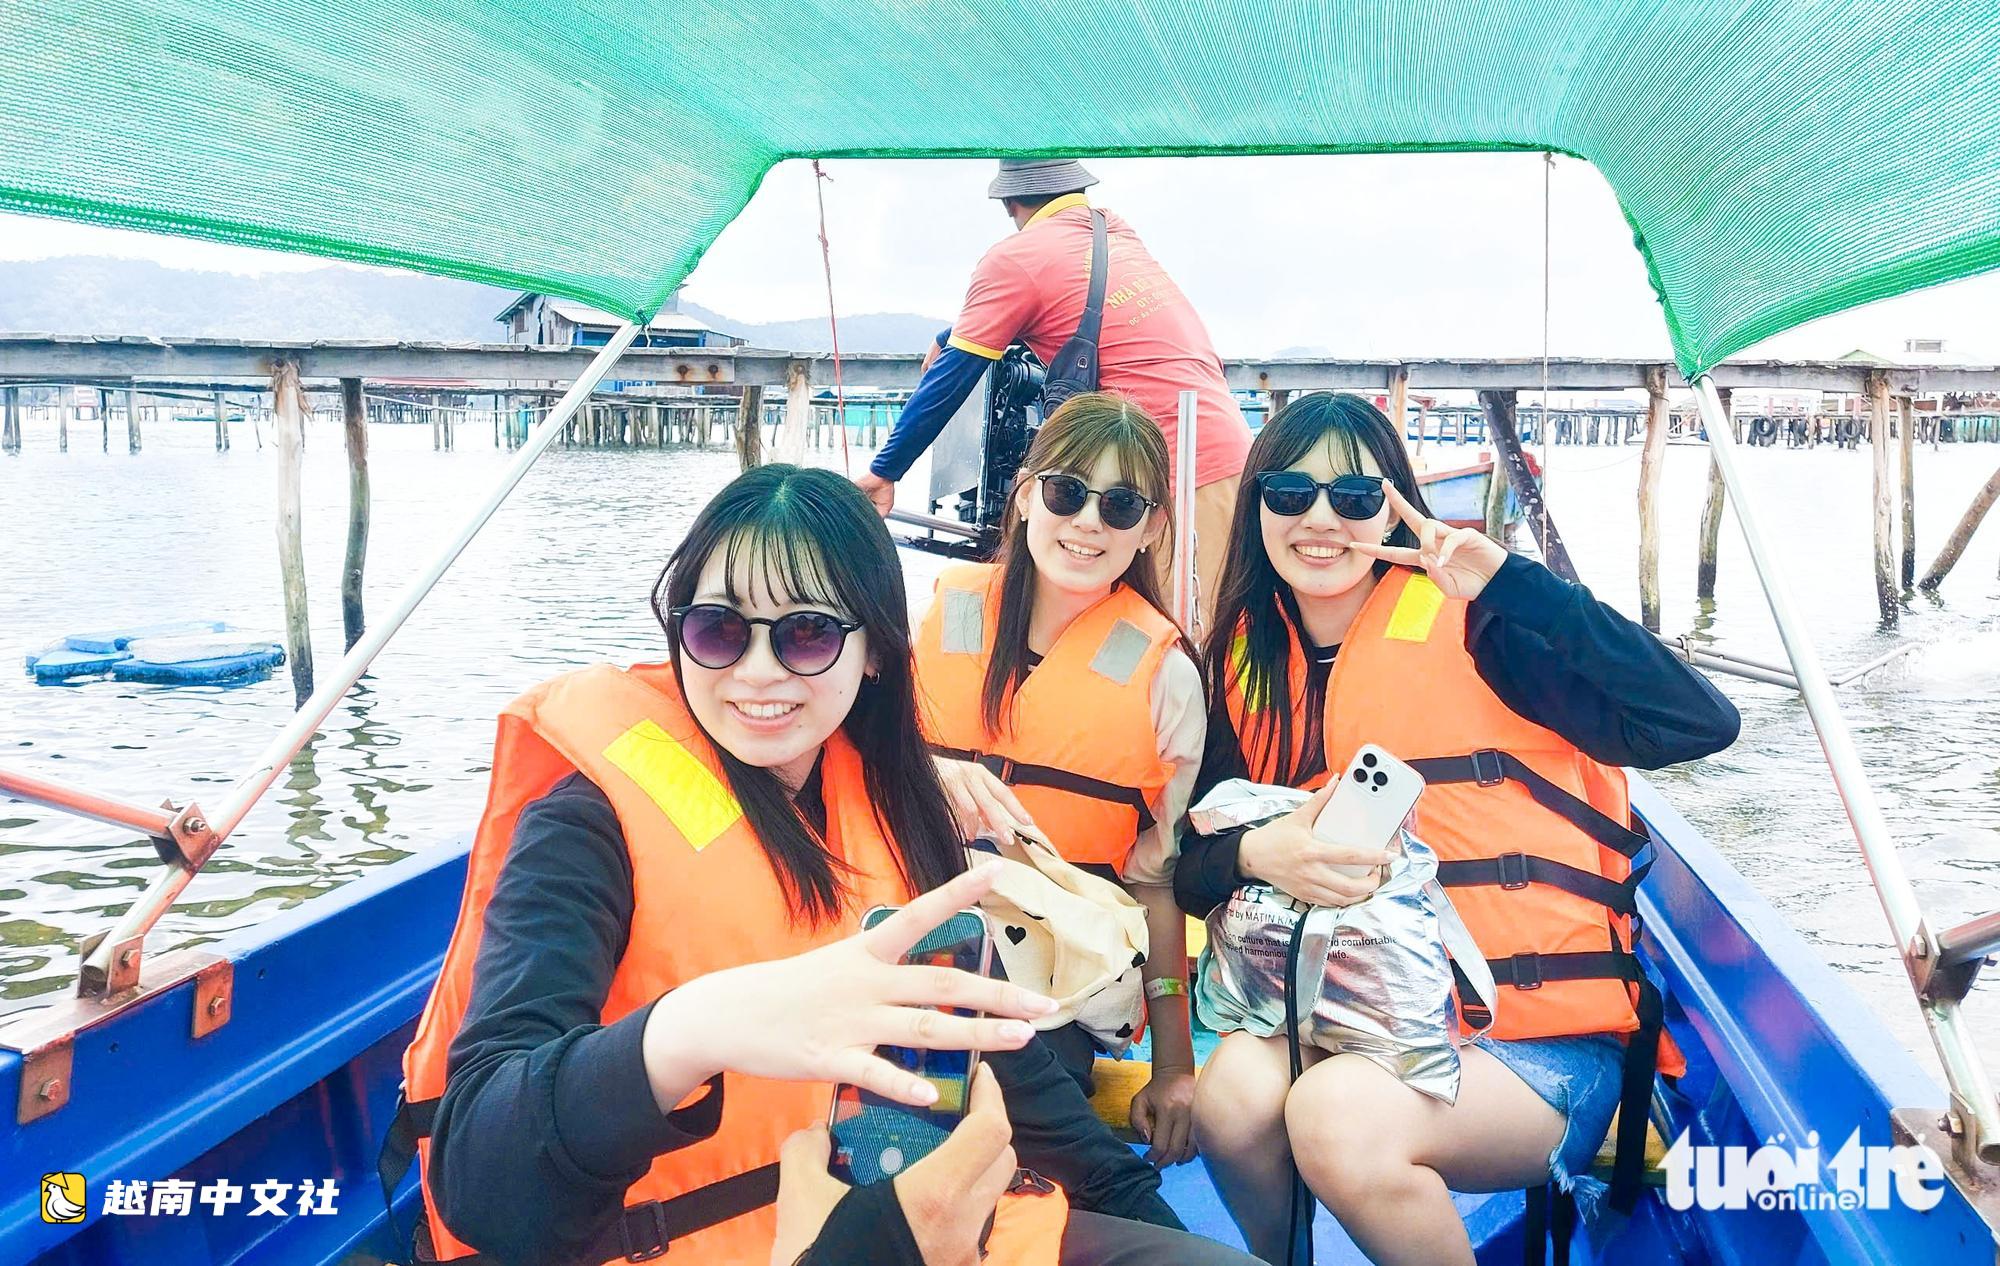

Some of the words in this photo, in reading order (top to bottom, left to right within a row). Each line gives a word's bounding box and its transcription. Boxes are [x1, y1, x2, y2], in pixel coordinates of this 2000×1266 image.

[1107, 284, 1137, 309] NHÀ
[1235, 911, 1244, 920] by
[1245, 911, 1275, 924] MATIN
[1277, 915, 1297, 926] KIM
[1237, 935, 1264, 946] culture
[1265, 938, 1281, 947] that
[1341, 936, 1397, 947] comfortable
[1244, 945, 1287, 958] harmoniou
[1332, 950, 1349, 959] life.
